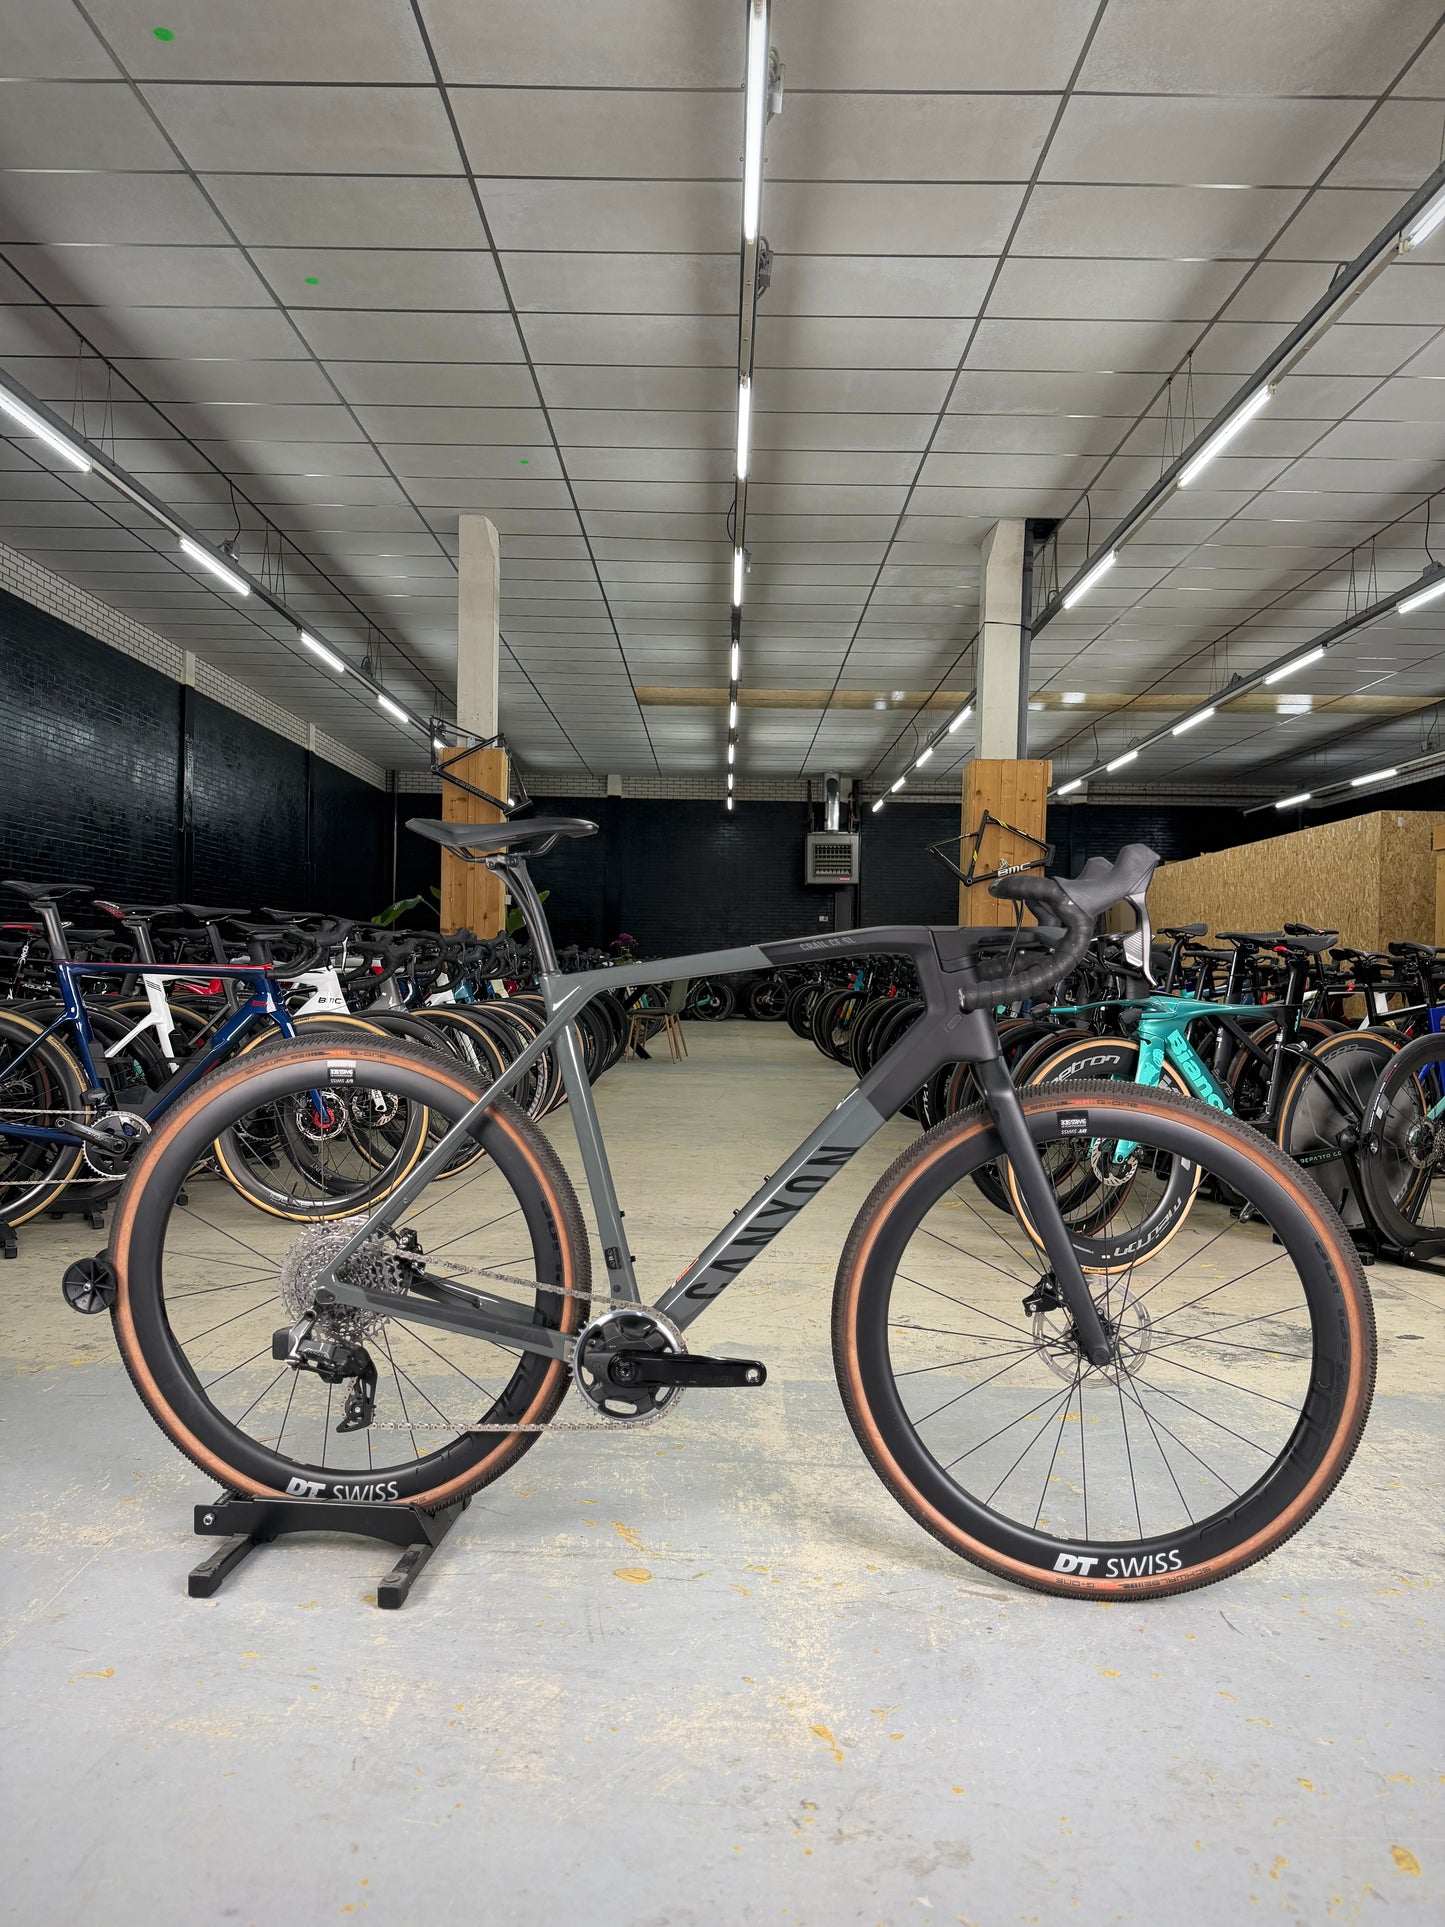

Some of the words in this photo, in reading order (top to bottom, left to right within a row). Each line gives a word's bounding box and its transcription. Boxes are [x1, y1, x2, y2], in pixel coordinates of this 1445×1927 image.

[997, 862, 1031, 877] BMC
[685, 1145, 861, 1300] CANYON
[285, 1476, 326, 1499] DT
[333, 1481, 399, 1501] SWISS
[1053, 1552, 1099, 1577] DT
[1105, 1549, 1183, 1578] SWISS
